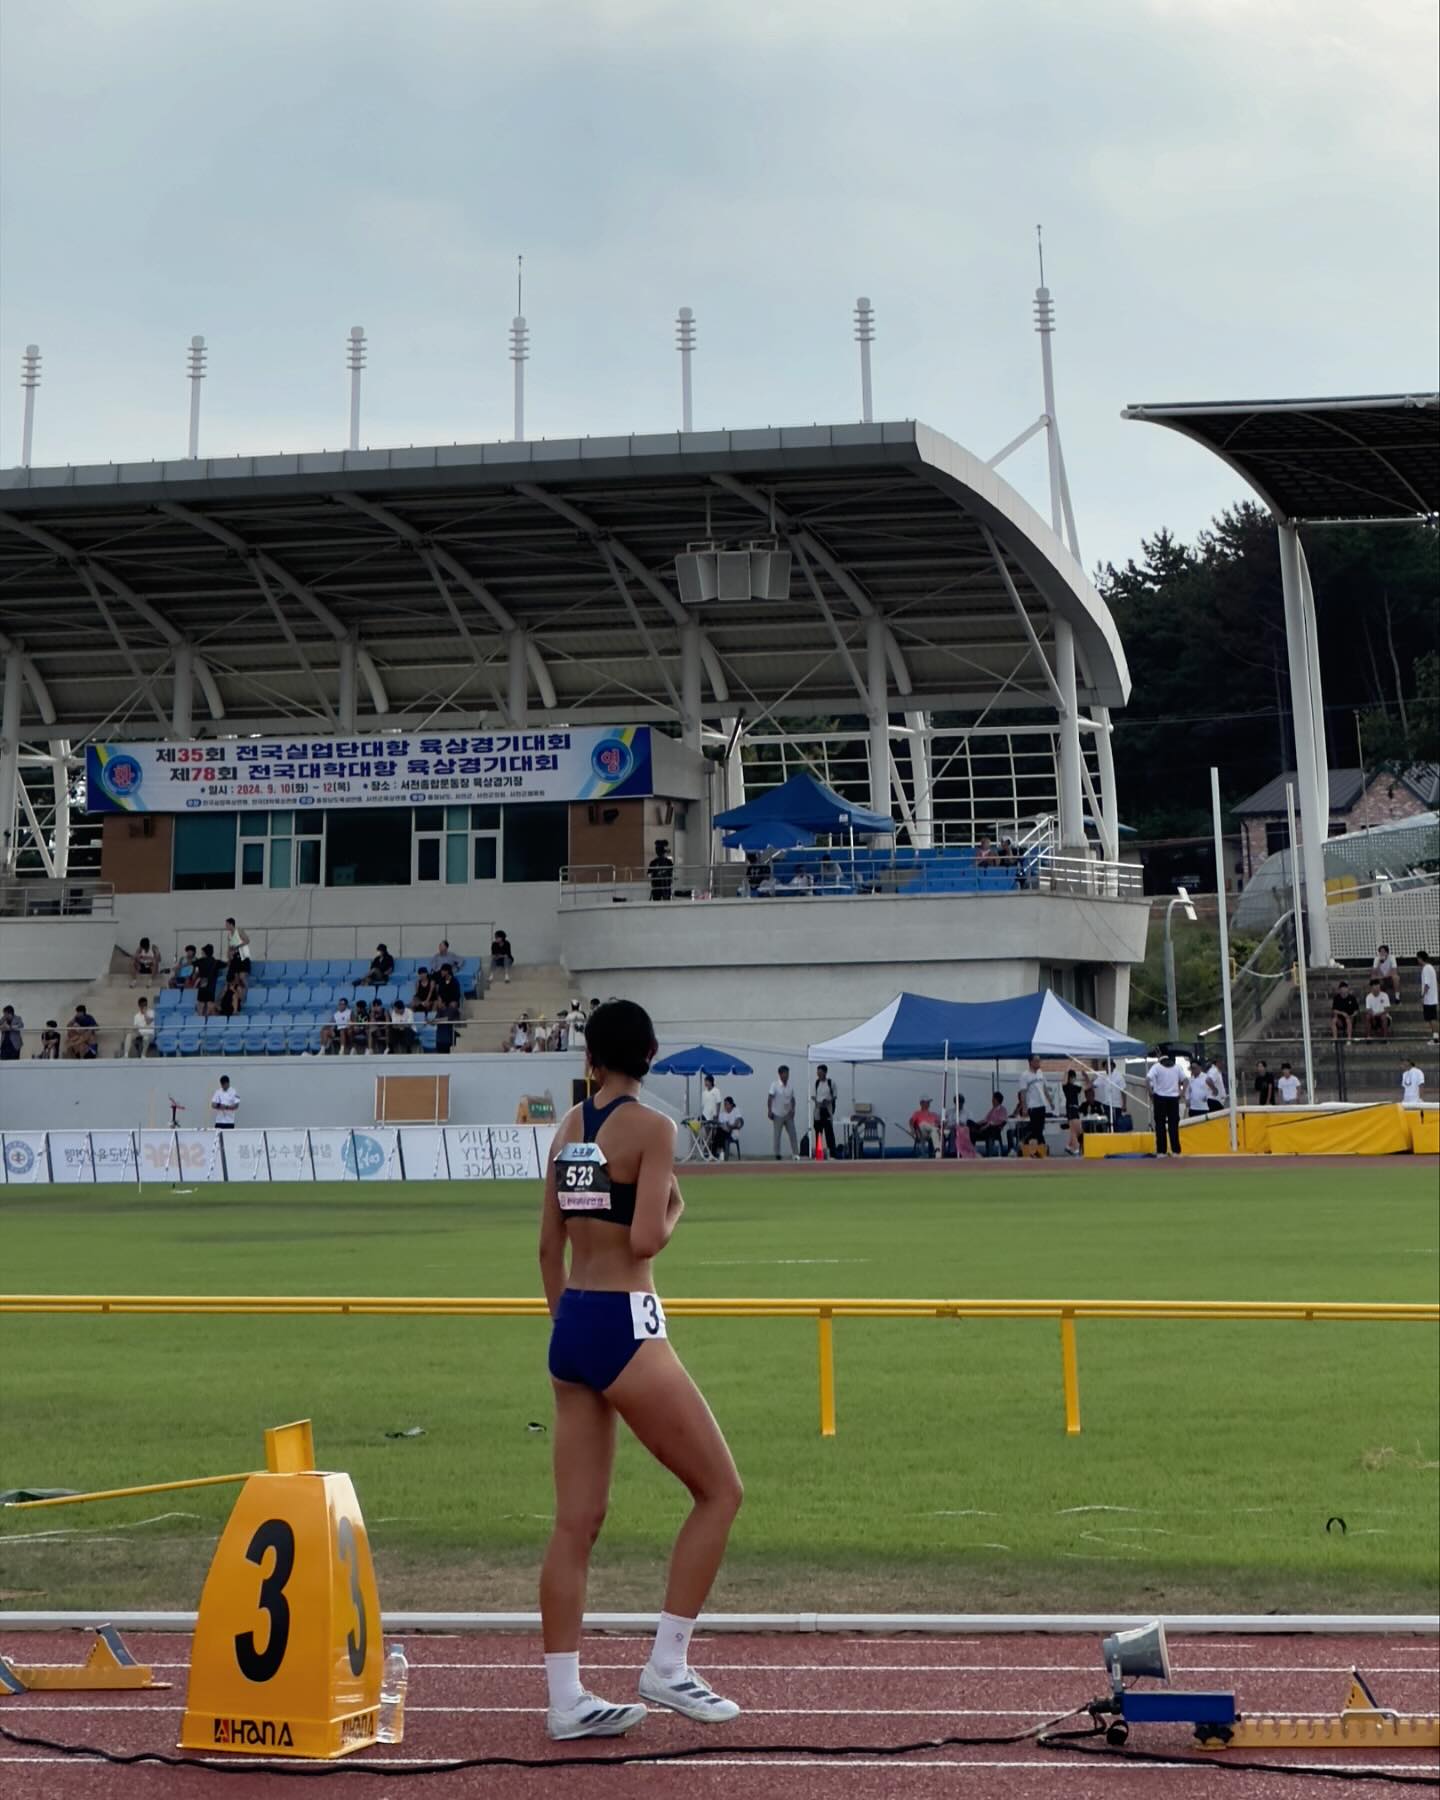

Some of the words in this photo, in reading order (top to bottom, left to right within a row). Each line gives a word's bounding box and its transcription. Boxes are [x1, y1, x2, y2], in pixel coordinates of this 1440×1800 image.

[156, 748, 226, 763] 제35회
[236, 740, 410, 762] 전국실업단대항
[419, 733, 572, 755] 육상경기대회
[170, 765, 238, 782] 제78회
[249, 760, 398, 780] 전국대학대항
[407, 754, 559, 775] 육상경기대회
[473, 776, 523, 787] 육상경기장
[566, 1165, 594, 1186] 523
[643, 1295, 660, 1335] 3
[235, 1518, 295, 1683] 3
[338, 1515, 367, 1678] 3
